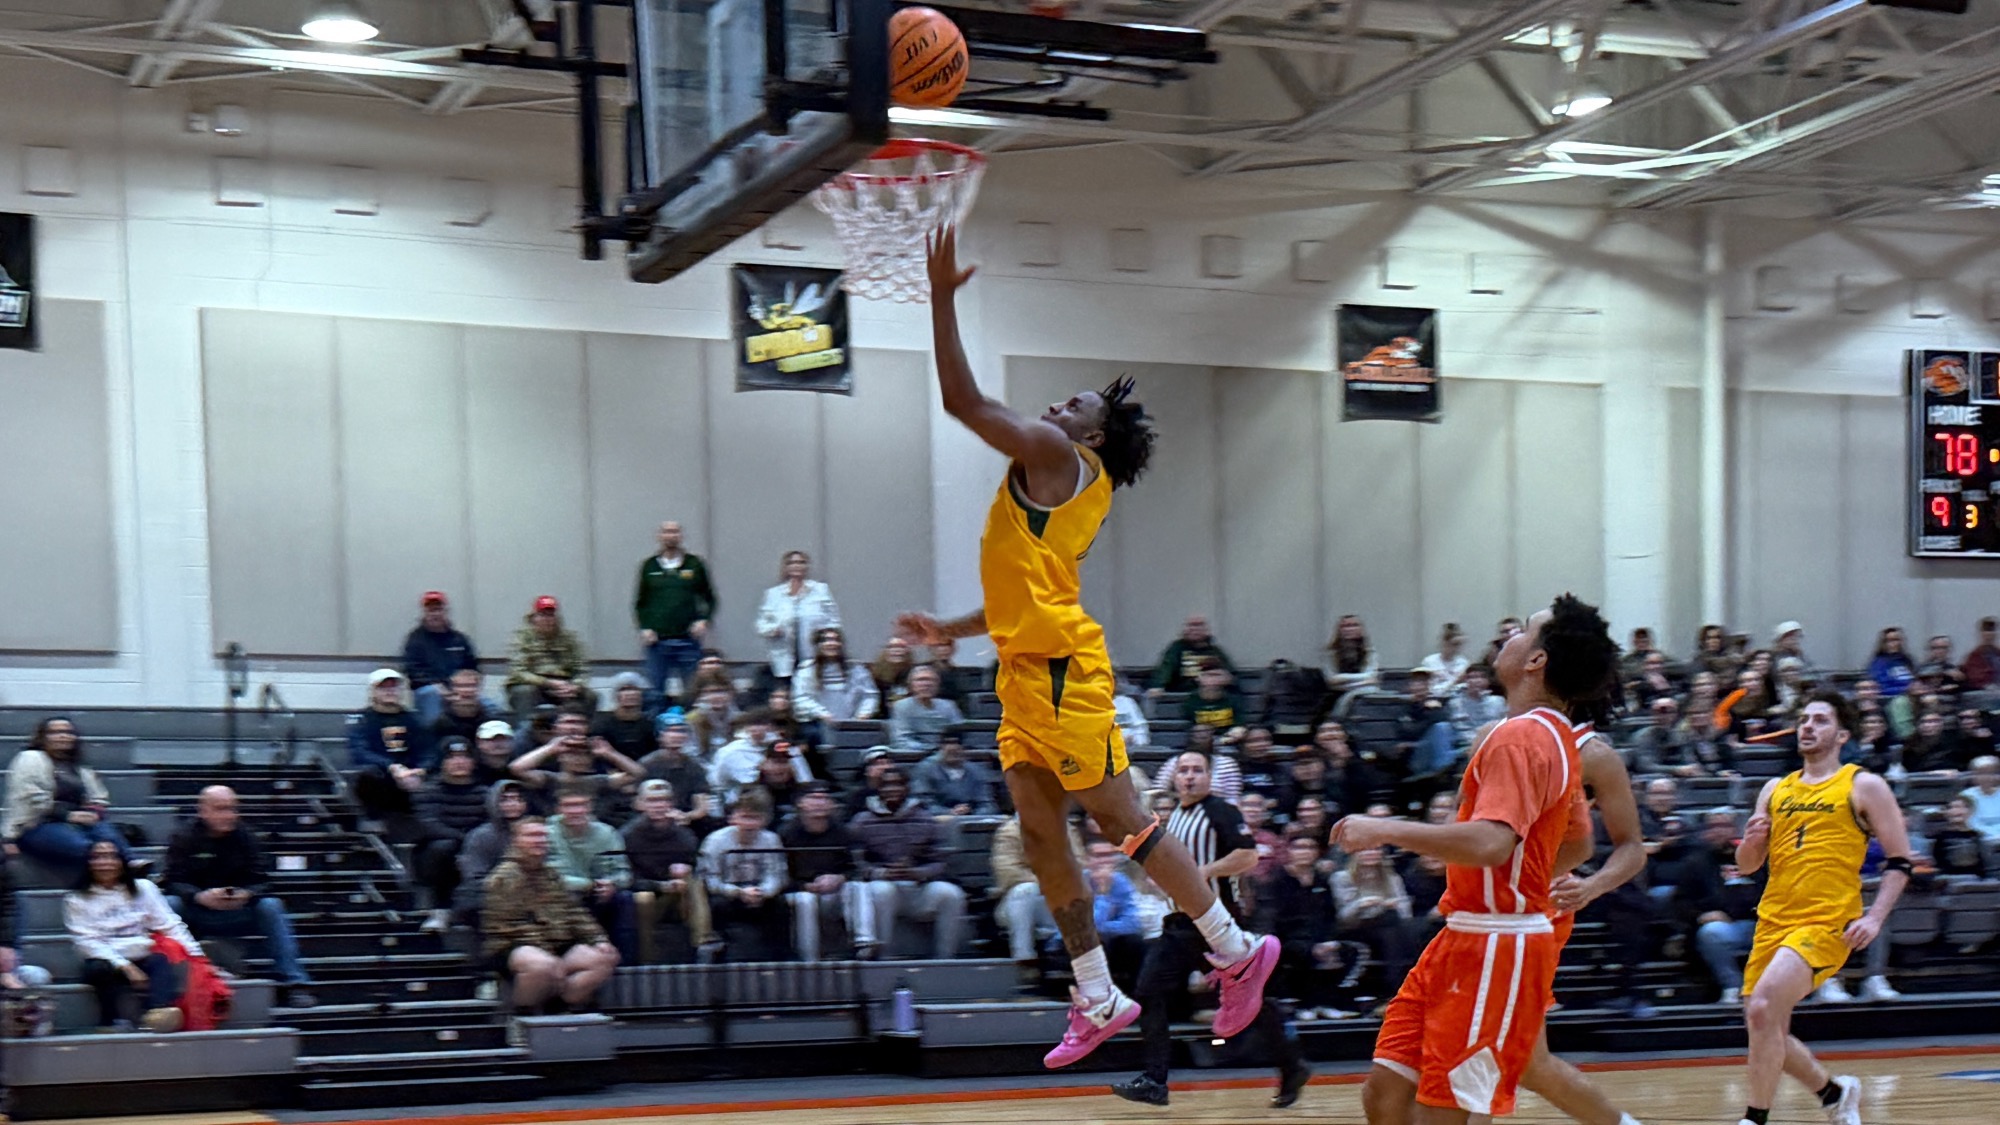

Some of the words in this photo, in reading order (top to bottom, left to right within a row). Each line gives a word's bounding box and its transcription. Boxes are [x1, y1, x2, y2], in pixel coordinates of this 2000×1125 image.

[1934, 432, 1977, 475] 78
[1931, 496, 1949, 527] 9
[1965, 504, 1978, 529] 3
[1794, 823, 1806, 850] 1
